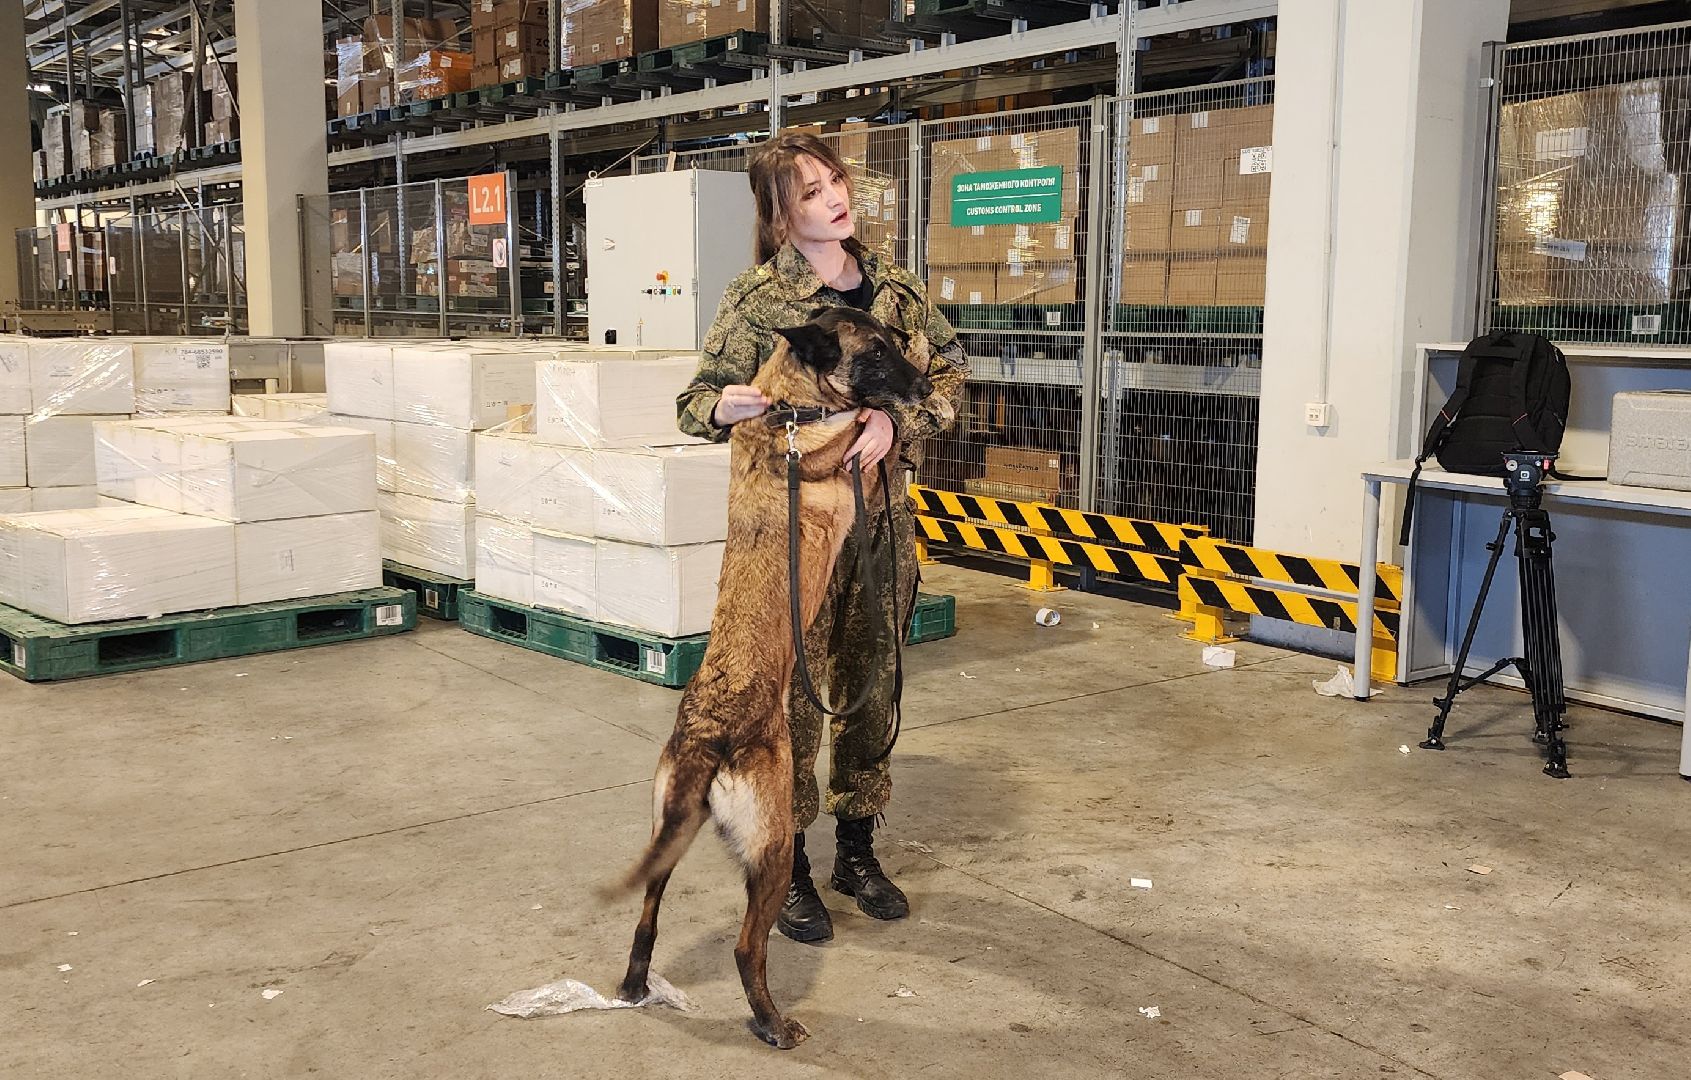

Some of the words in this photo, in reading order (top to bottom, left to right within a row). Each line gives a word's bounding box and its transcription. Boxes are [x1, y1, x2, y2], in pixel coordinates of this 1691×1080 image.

[956, 183, 973, 193] ЗОНА
[973, 179, 1019, 191] ТАМОЖЕННОГО
[1020, 177, 1056, 188] КОНТРОЛЯ
[472, 184, 501, 214] L2.1
[966, 206, 994, 216] CUSTOMS
[994, 204, 1024, 214] CONTROL
[1024, 203, 1042, 213] ZONE
